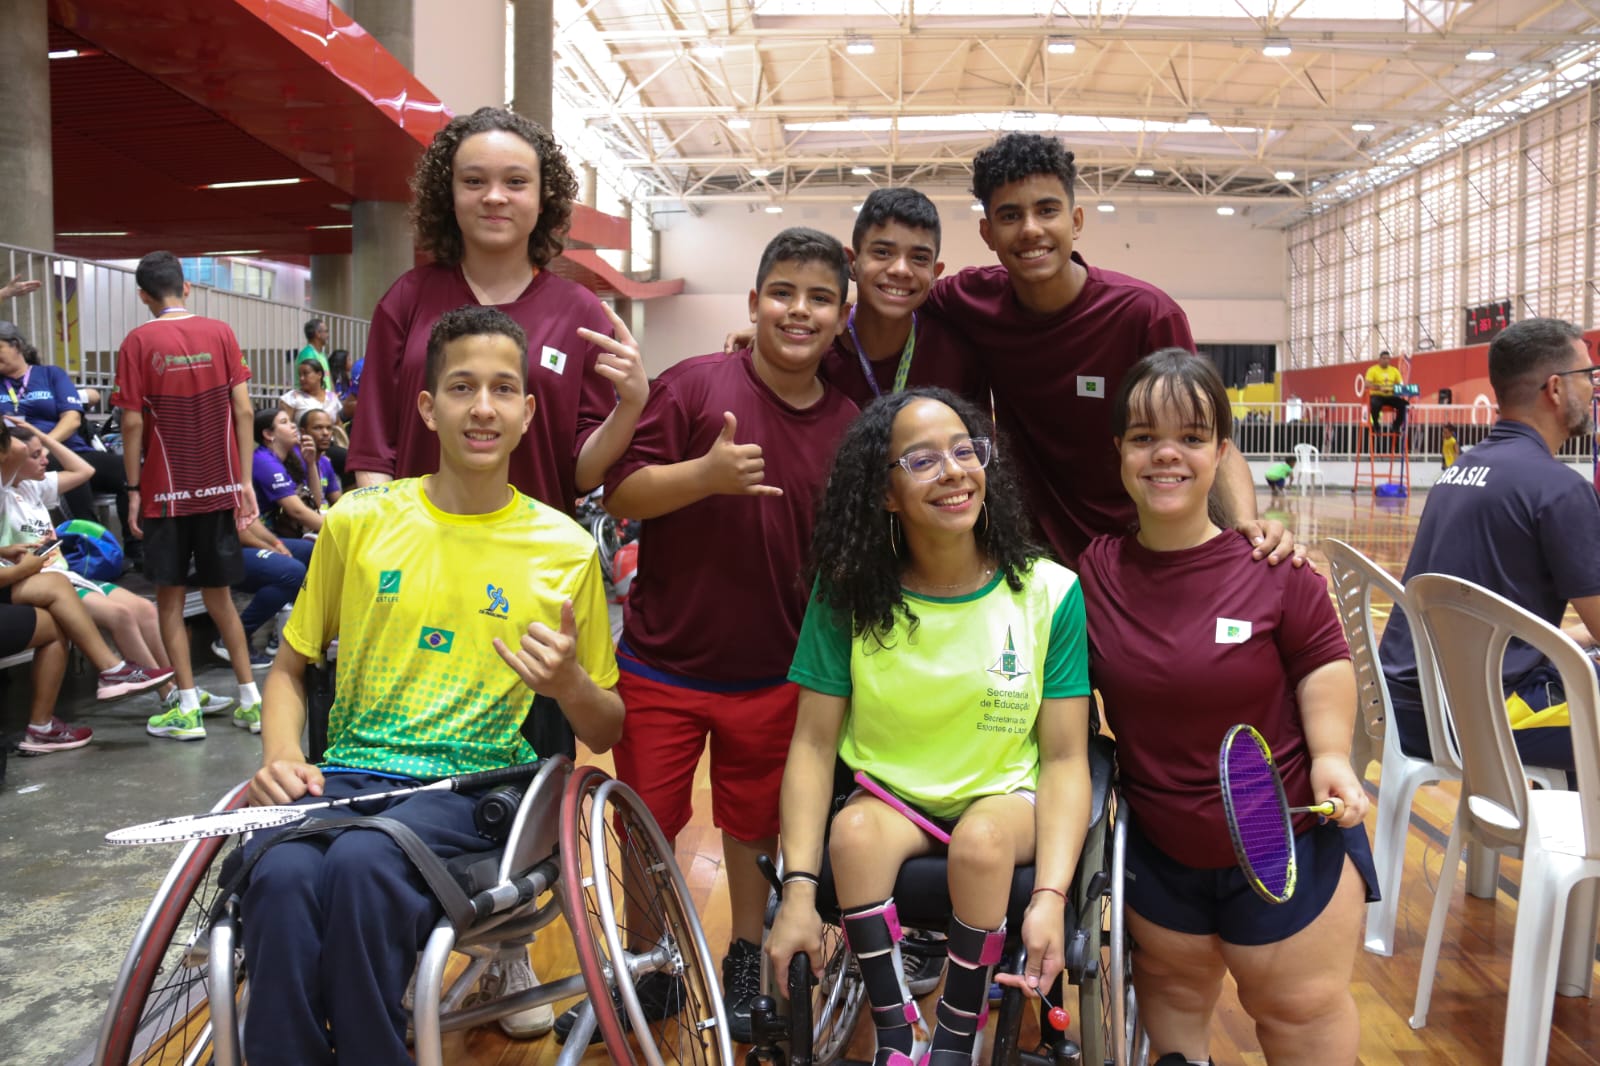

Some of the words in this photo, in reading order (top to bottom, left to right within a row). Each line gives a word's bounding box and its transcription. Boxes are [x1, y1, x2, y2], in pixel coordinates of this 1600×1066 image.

[154, 490, 191, 502] SANTA
[195, 483, 243, 498] CATARIN
[986, 687, 1029, 699] Secretaria
[979, 699, 992, 708] de
